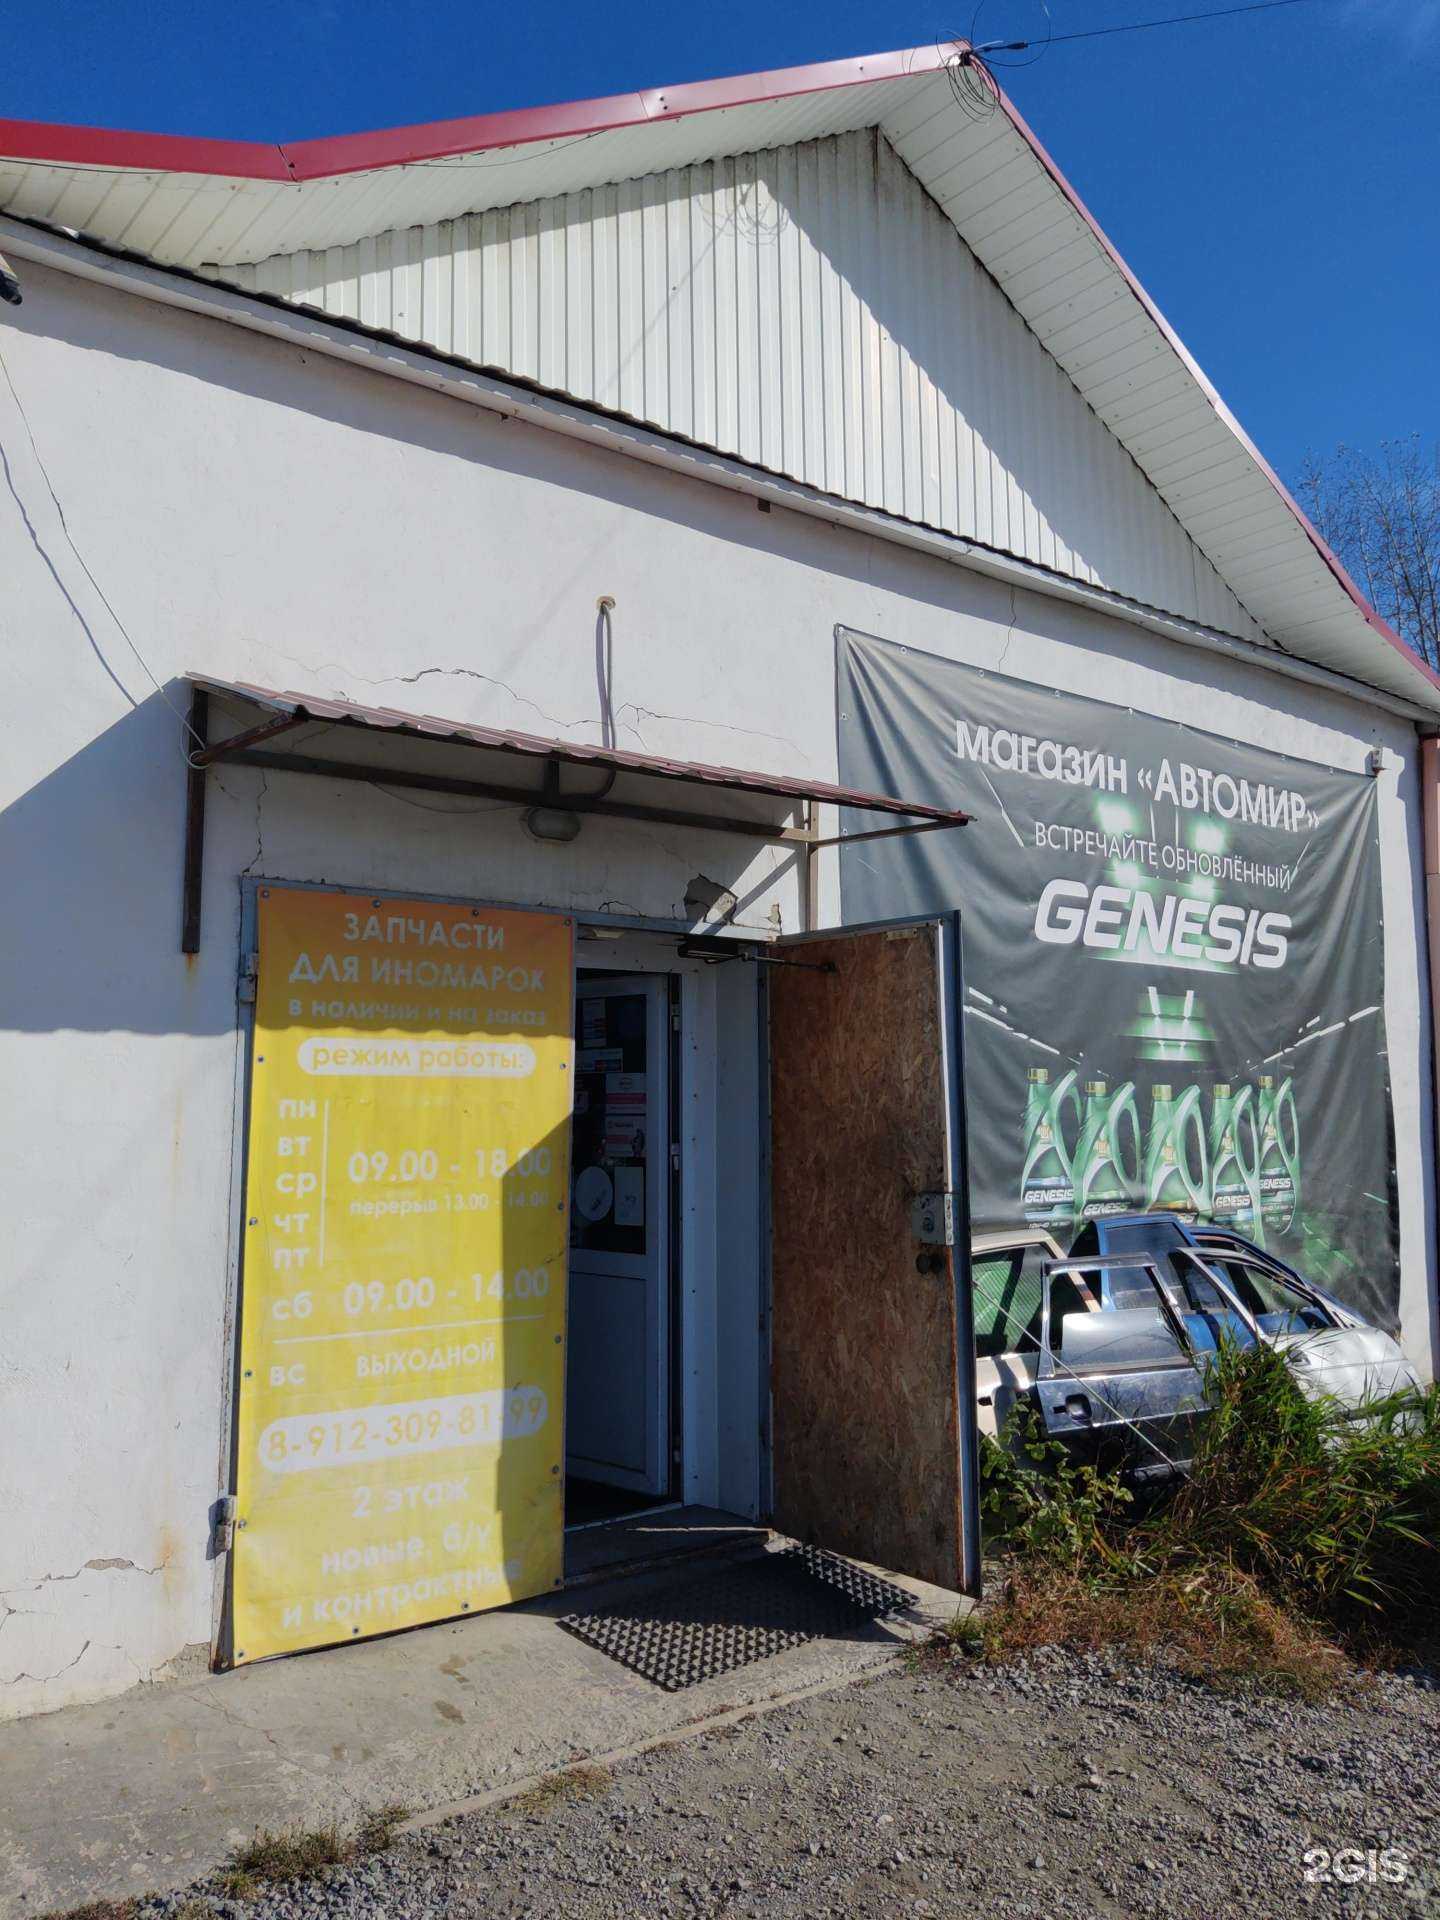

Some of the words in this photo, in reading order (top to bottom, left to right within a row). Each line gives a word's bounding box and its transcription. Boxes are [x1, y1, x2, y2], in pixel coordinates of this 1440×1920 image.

[954, 719, 1128, 795] Магазин
[1136, 757, 1321, 833] «АВТОМИР»
[1034, 821, 1158, 866] ВСТРЕЧАЙТЕ
[1162, 844, 1292, 892] ОБНОВЛЁННЫЙ
[343, 912, 505, 951] ЗАПЧАСТИ
[1034, 878, 1292, 969] GENESIS
[287, 951, 360, 986] ДЛЯ
[371, 959, 546, 995] ИНОМАРОК
[311, 1000, 420, 1022] наличии
[427, 1006, 441, 1022] и
[447, 1006, 479, 1026] на
[486, 1007, 546, 1027] заказ
[312, 1046, 412, 1071] режим
[418, 1045, 526, 1075] работы:
[275, 1171, 318, 1200] ср
[348, 1148, 440, 1184] 09.00
[474, 1147, 552, 1179] 18.00
[350, 1198, 438, 1218] перерыв
[1024, 1188, 1074, 1204] GENESIS
[274, 1211, 311, 1234] чт
[271, 1290, 313, 1321] сб
[343, 1275, 435, 1317] 09.00
[470, 1267, 549, 1301] 14.00
[267, 1396, 543, 1461] 8-912-309-81-99
[352, 1486, 371, 1518] 2
[384, 1475, 472, 1513] этаж
[281, 1604, 304, 1629] и
[312, 1558, 524, 1622] контрактные
